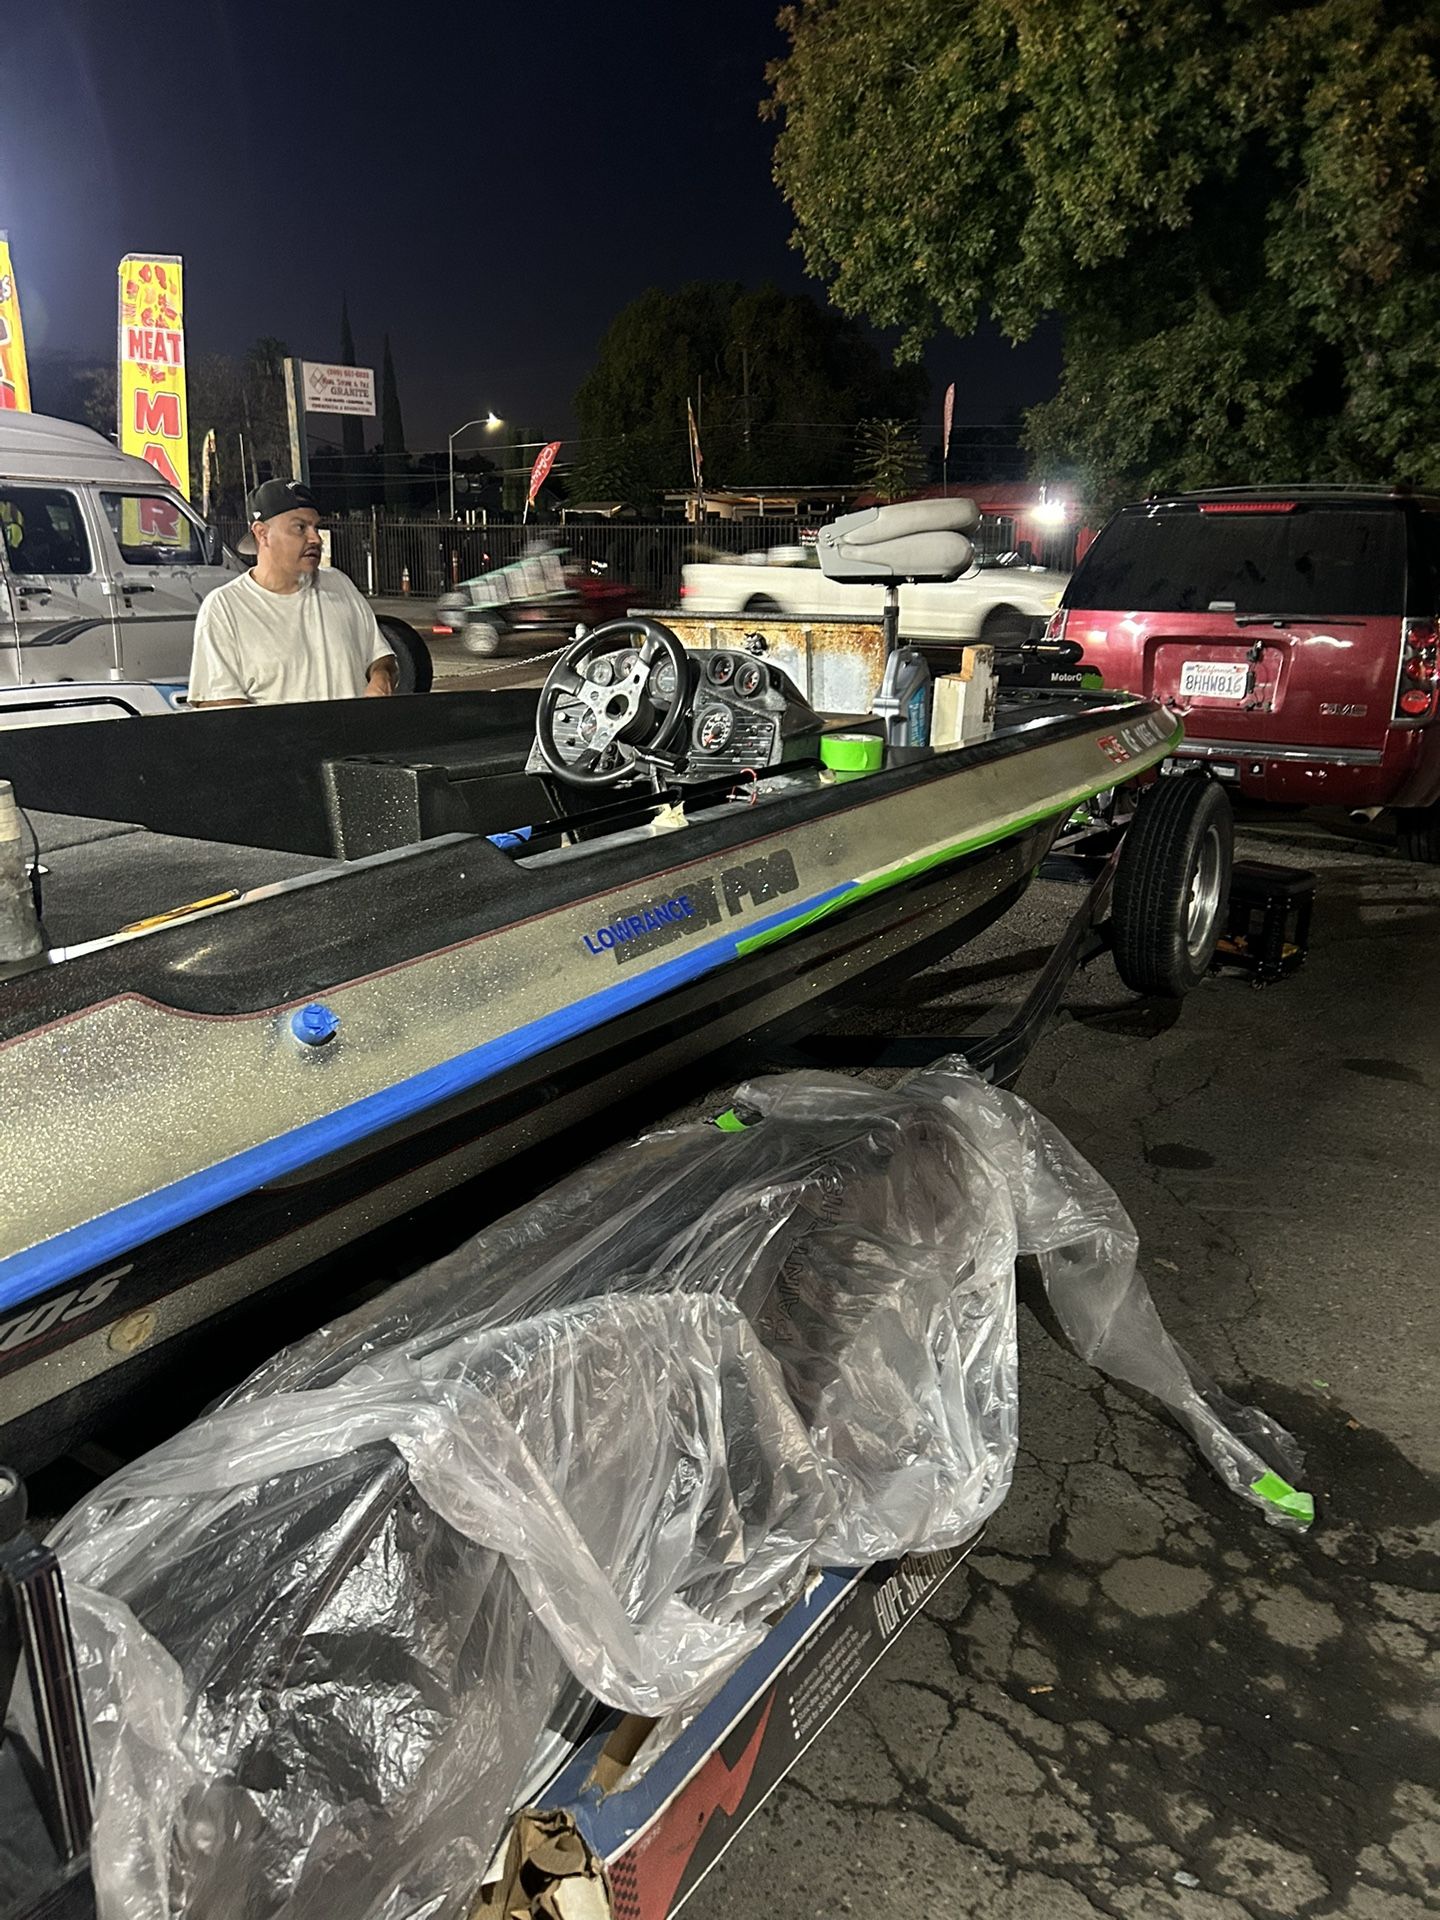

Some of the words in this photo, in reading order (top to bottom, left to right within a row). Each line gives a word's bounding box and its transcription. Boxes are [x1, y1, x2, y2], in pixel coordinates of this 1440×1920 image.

[127, 327, 182, 365] MEAT
[331, 386, 370, 398] GRANITE
[133, 388, 183, 545] MAR
[1050, 672, 1091, 682] MotorG
[1185, 674, 1243, 694] 8HHW816
[582, 895, 696, 955] LOWRANCE
